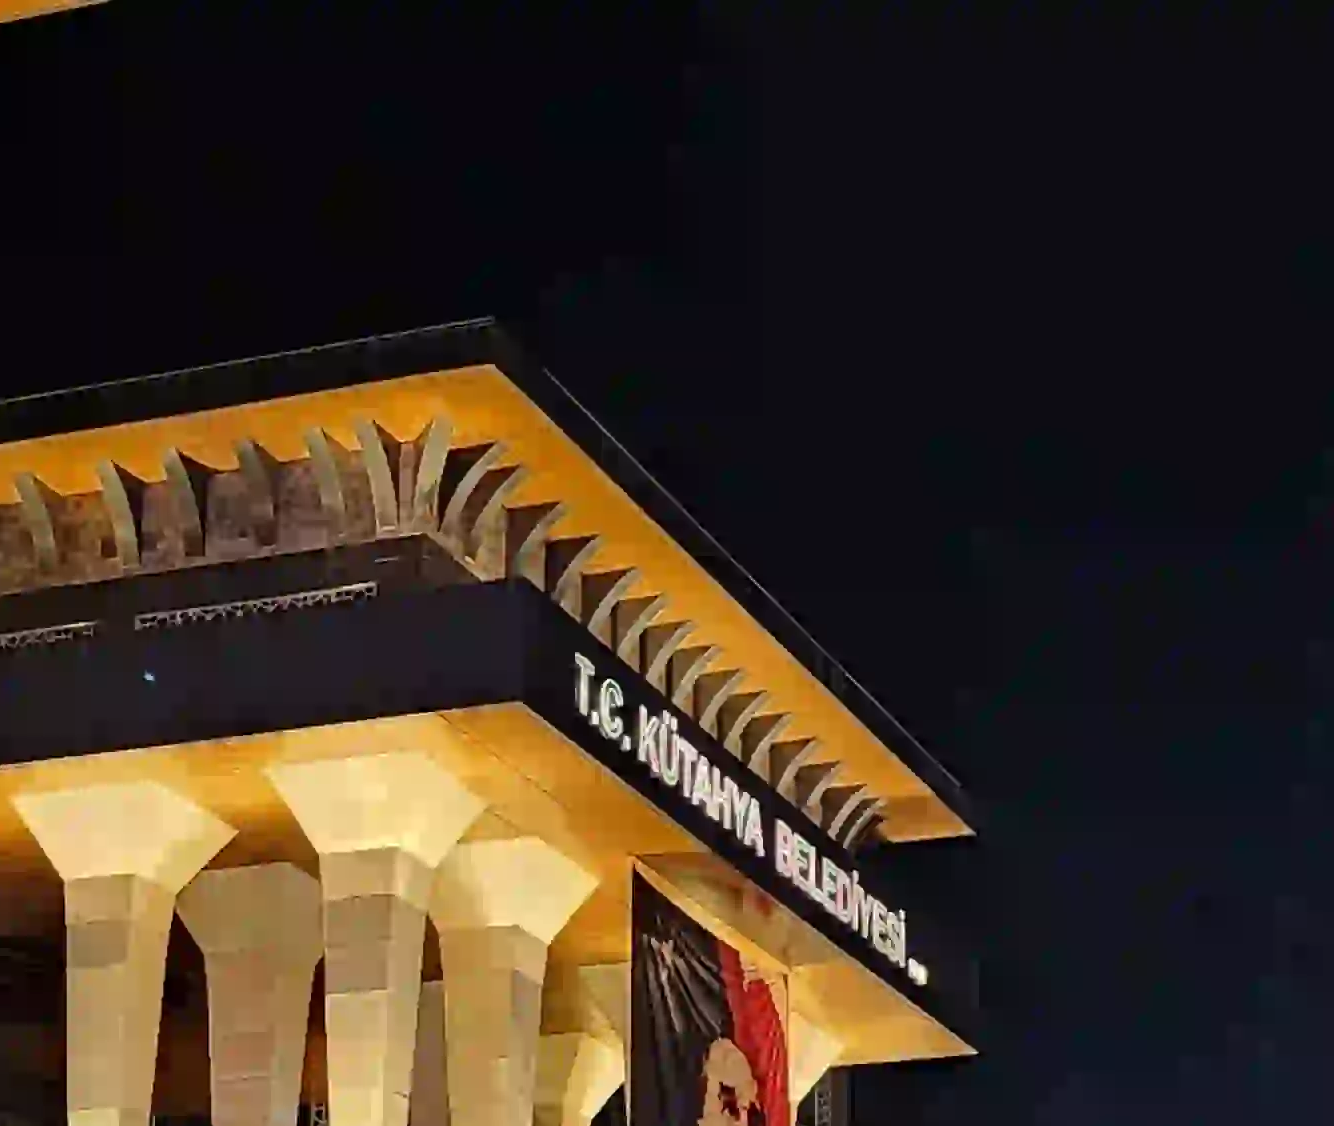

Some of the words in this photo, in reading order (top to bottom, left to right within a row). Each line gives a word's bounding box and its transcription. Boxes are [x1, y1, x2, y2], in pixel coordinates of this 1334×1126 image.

[573, 651, 631, 751] T.C.
[637, 703, 766, 858] KÜTAHYA
[774, 818, 907, 968] BELEDİYESİ
